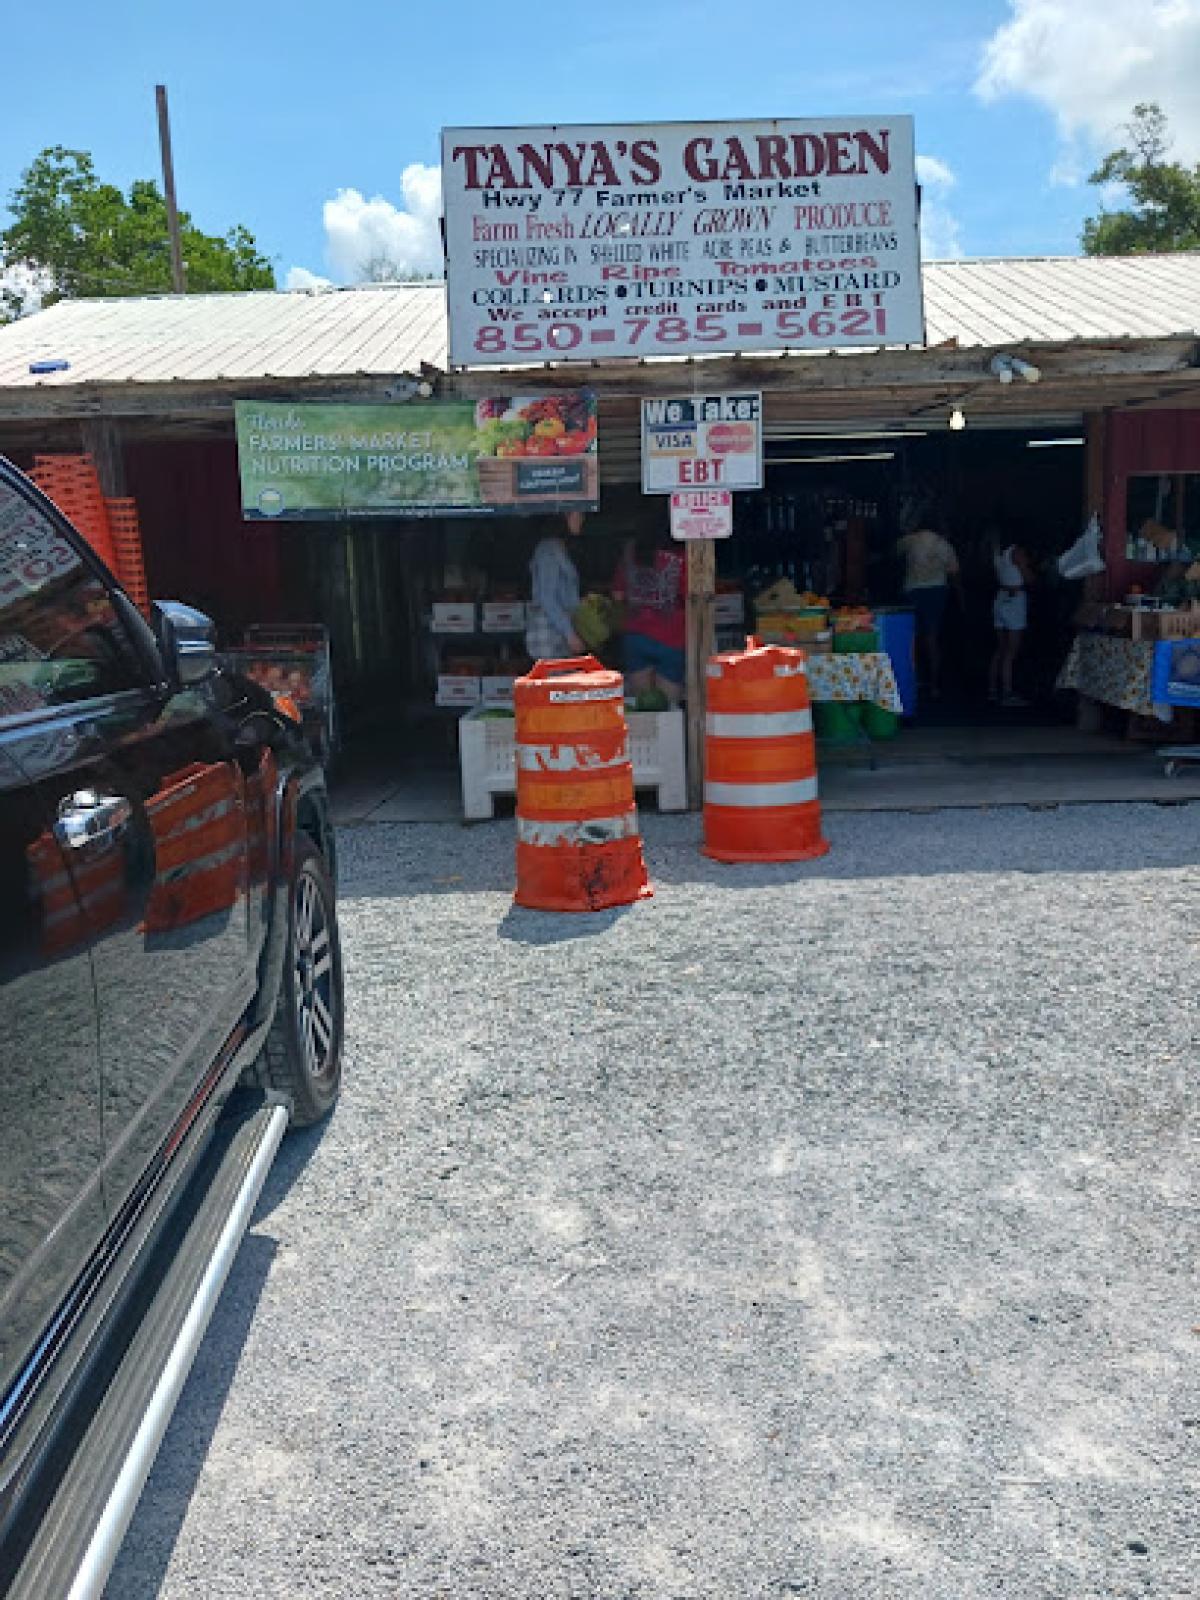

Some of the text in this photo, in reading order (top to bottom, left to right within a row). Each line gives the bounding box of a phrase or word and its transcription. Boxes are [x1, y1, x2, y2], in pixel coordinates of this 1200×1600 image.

[452, 129, 892, 189] TANYA'S GARDEN
[482, 181, 822, 213] Hwy 77 Farmer's Market
[472, 200, 893, 242] Farm Fresh LOCALLY GROWN PRODUCE
[473, 247, 560, 269] SPECIALIZING
[649, 240, 691, 263] WHITE
[702, 237, 734, 260] ACRE
[740, 237, 773, 258] PEAS
[778, 237, 793, 254] &
[804, 231, 899, 257] BUTTERBEANS
[494, 255, 879, 287] Vine Ripe Tomatoes
[628, 276, 749, 302] TURNIPS
[773, 270, 902, 296] MUSTARD
[487, 307, 525, 322] We
[537, 305, 608, 322] accept
[624, 301, 679, 317] credit
[696, 298, 748, 313] cards
[762, 295, 808, 311] and
[472, 308, 888, 355] 850-785-5621
[643, 399, 683, 425] We
[350, 431, 433, 449] MARKET
[655, 433, 693, 449] VISA
[251, 451, 469, 475] NUTRITION PROGRAM
[678, 458, 724, 484] EBT
